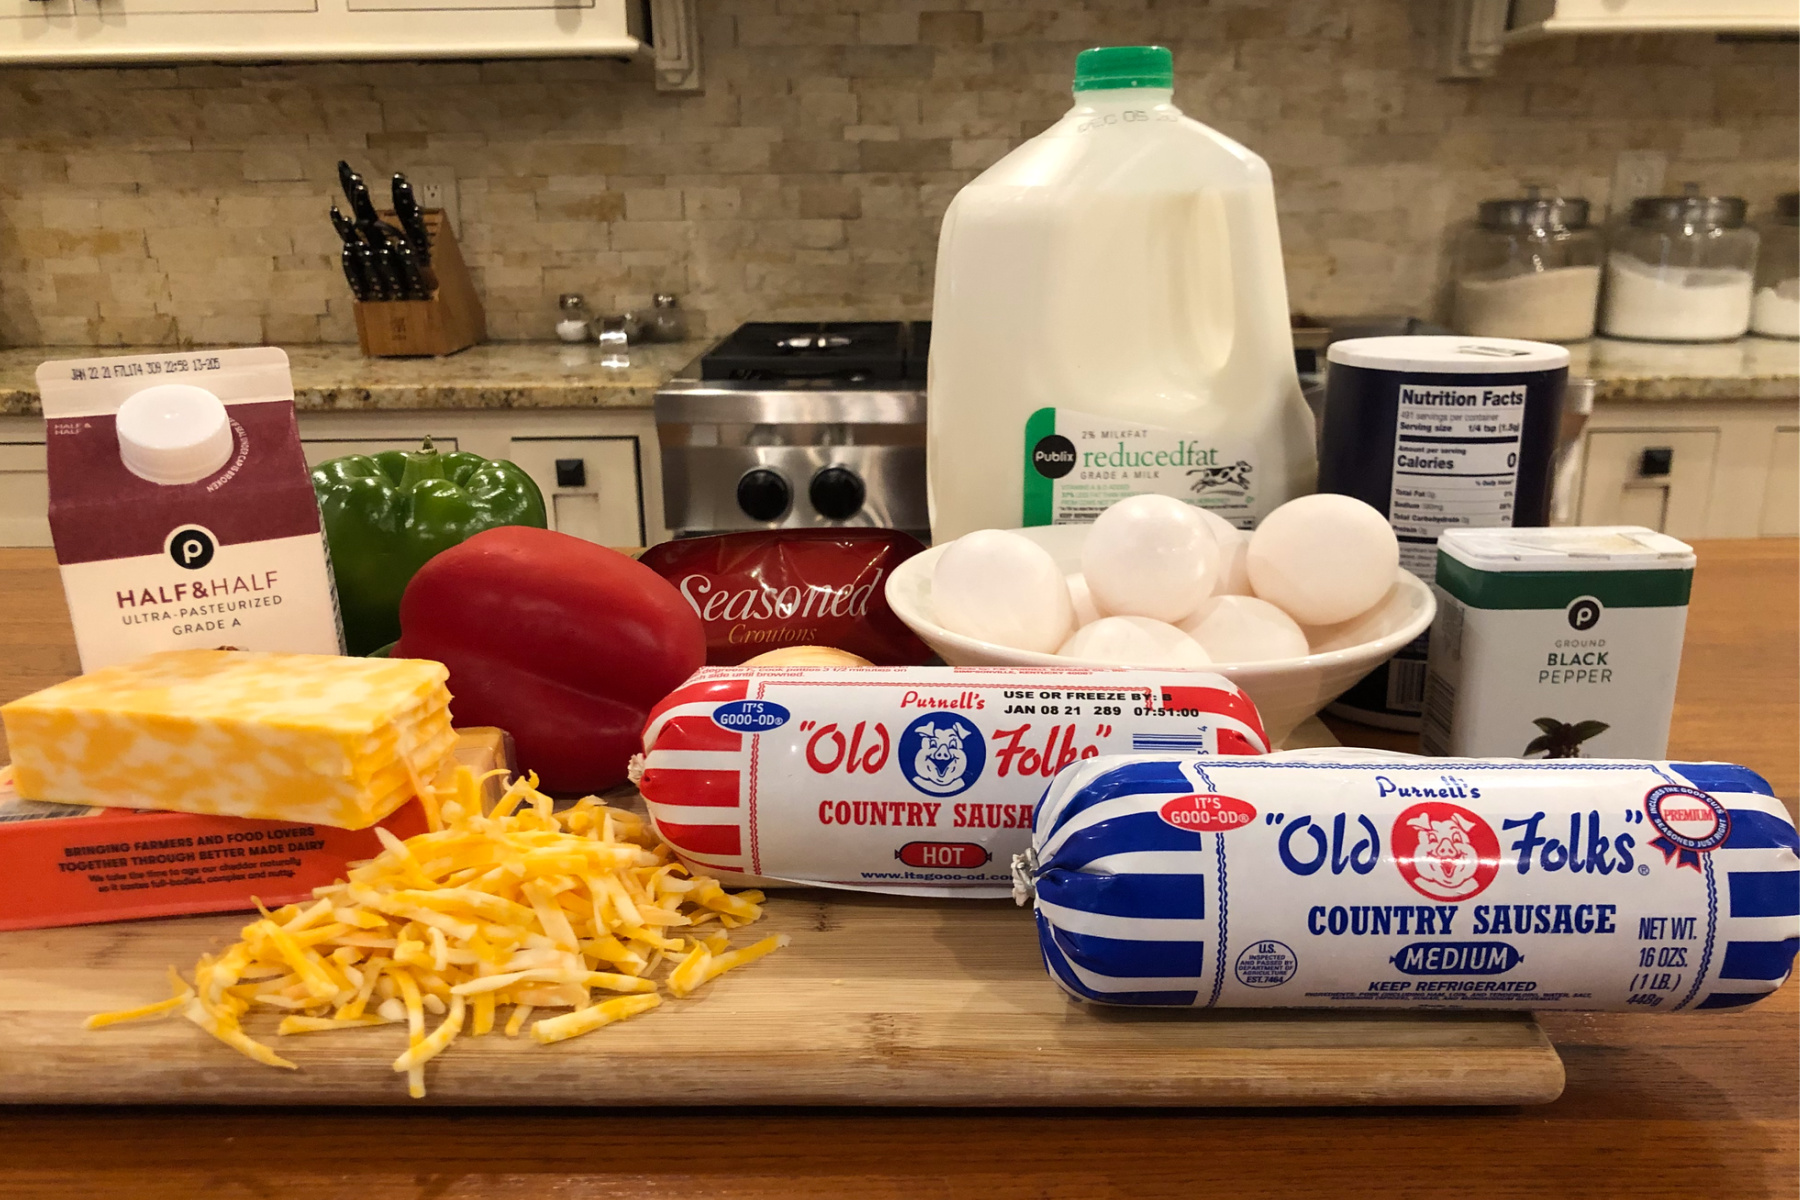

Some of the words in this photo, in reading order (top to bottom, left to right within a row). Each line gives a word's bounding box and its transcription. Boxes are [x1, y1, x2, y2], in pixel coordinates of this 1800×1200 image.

[71, 368, 86, 381] JAN
[89, 367, 99, 379] 22
[101, 366, 111, 379] 21
[146, 362, 162, 375] 309
[1402, 389, 1477, 406] Nutrition
[1482, 391, 1523, 406] Facts
[1416, 413, 1448, 423] servings
[1450, 415, 1462, 423] per
[1082, 431, 1096, 439] 2%
[1100, 430, 1148, 439] MILKFAT
[1400, 421, 1432, 433] Serving
[1434, 424, 1452, 432] size
[1484, 425, 1497, 433] tsp
[1035, 451, 1074, 462] Publix
[1083, 440, 1219, 468] reducedfat
[1398, 445, 1425, 453] Amount
[1397, 455, 1455, 469] Calories
[1507, 452, 1517, 468] 0
[206, 470, 236, 492] BROKEN
[1080, 471, 1117, 480] GRADE
[1122, 471, 1129, 479] A
[1134, 470, 1160, 479] MILK
[1394, 501, 1420, 509] Sodium
[1412, 514, 1460, 523] Carbohydrate
[116, 570, 279, 609] HALF&HALF
[679, 567, 883, 622] Seasoned
[122, 594, 283, 625] ULTRA-PASTEURIZED
[172, 618, 225, 636] GRADE
[232, 618, 242, 628] A
[728, 623, 818, 645] Croutons
[1555, 639, 1606, 648] GROUND
[1547, 651, 1609, 667] BLACK
[1538, 669, 1613, 684] PEPPER
[900, 691, 985, 710] Purnell's
[1004, 691, 1034, 699] USE
[1039, 692, 1062, 700] OR
[1067, 692, 1126, 701] FREEZE
[1132, 693, 1157, 701] BY:
[1162, 693, 1172, 701] B
[742, 702, 764, 714] IT'S
[1004, 705, 1035, 715] JAN
[1041, 706, 1059, 715] 08
[1064, 706, 1081, 715] 21
[1093, 706, 1121, 716] 289
[1134, 707, 1200, 718] 07:51:00
[1375, 775, 1481, 799] Purnell's
[1194, 796, 1222, 809] IT'S
[1648, 787, 1666, 814] INCLUDES
[1680, 787, 1706, 799] GOOD
[1706, 797, 1725, 815] CUTS
[818, 800, 941, 827] COUNTRY
[953, 803, 1033, 829] SAUSA
[1663, 808, 1713, 821] PREMIUM
[64, 842, 131, 857] BRINGING
[133, 837, 194, 851] FARMERS
[197, 834, 224, 846] AND
[226, 831, 264, 843] FOOD
[267, 826, 315, 839] LOVERS
[1654, 818, 1695, 847] SEASONED
[1697, 837, 1716, 848] JUST
[1713, 818, 1727, 840] RIGHT
[58, 857, 128, 872] TOGETHER
[130, 852, 196, 866] THROUGH
[199, 847, 245, 860] BETTER
[248, 844, 285, 856] MADE
[287, 840, 325, 852] DAIRY
[923, 847, 965, 866] HOT
[88, 874, 104, 882] We
[106, 873, 127, 881] take
[128, 871, 145, 879] the
[146, 869, 168, 877] time
[168, 868, 180, 876] to
[180, 867, 199, 876] age
[220, 861, 257, 872] cheddar
[259, 856, 302, 868] naturally
[120, 882, 150, 891] tastes
[206, 873, 246, 883] complex
[247, 871, 266, 880] and
[1308, 905, 1458, 936] COUNTRY
[1473, 904, 1617, 934] SAUSAGE
[1638, 917, 1668, 940] NET
[1671, 917, 1698, 940] WT.
[1258, 943, 1277, 954] U.S.
[1639, 947, 1656, 967] 16
[1657, 947, 1688, 967] OZS.
[1403, 946, 1509, 971] MEDIUM
[1368, 981, 1412, 991] KEEP
[1415, 981, 1538, 992] REFRIGERATED
[1625, 993, 1664, 1007] 448g
